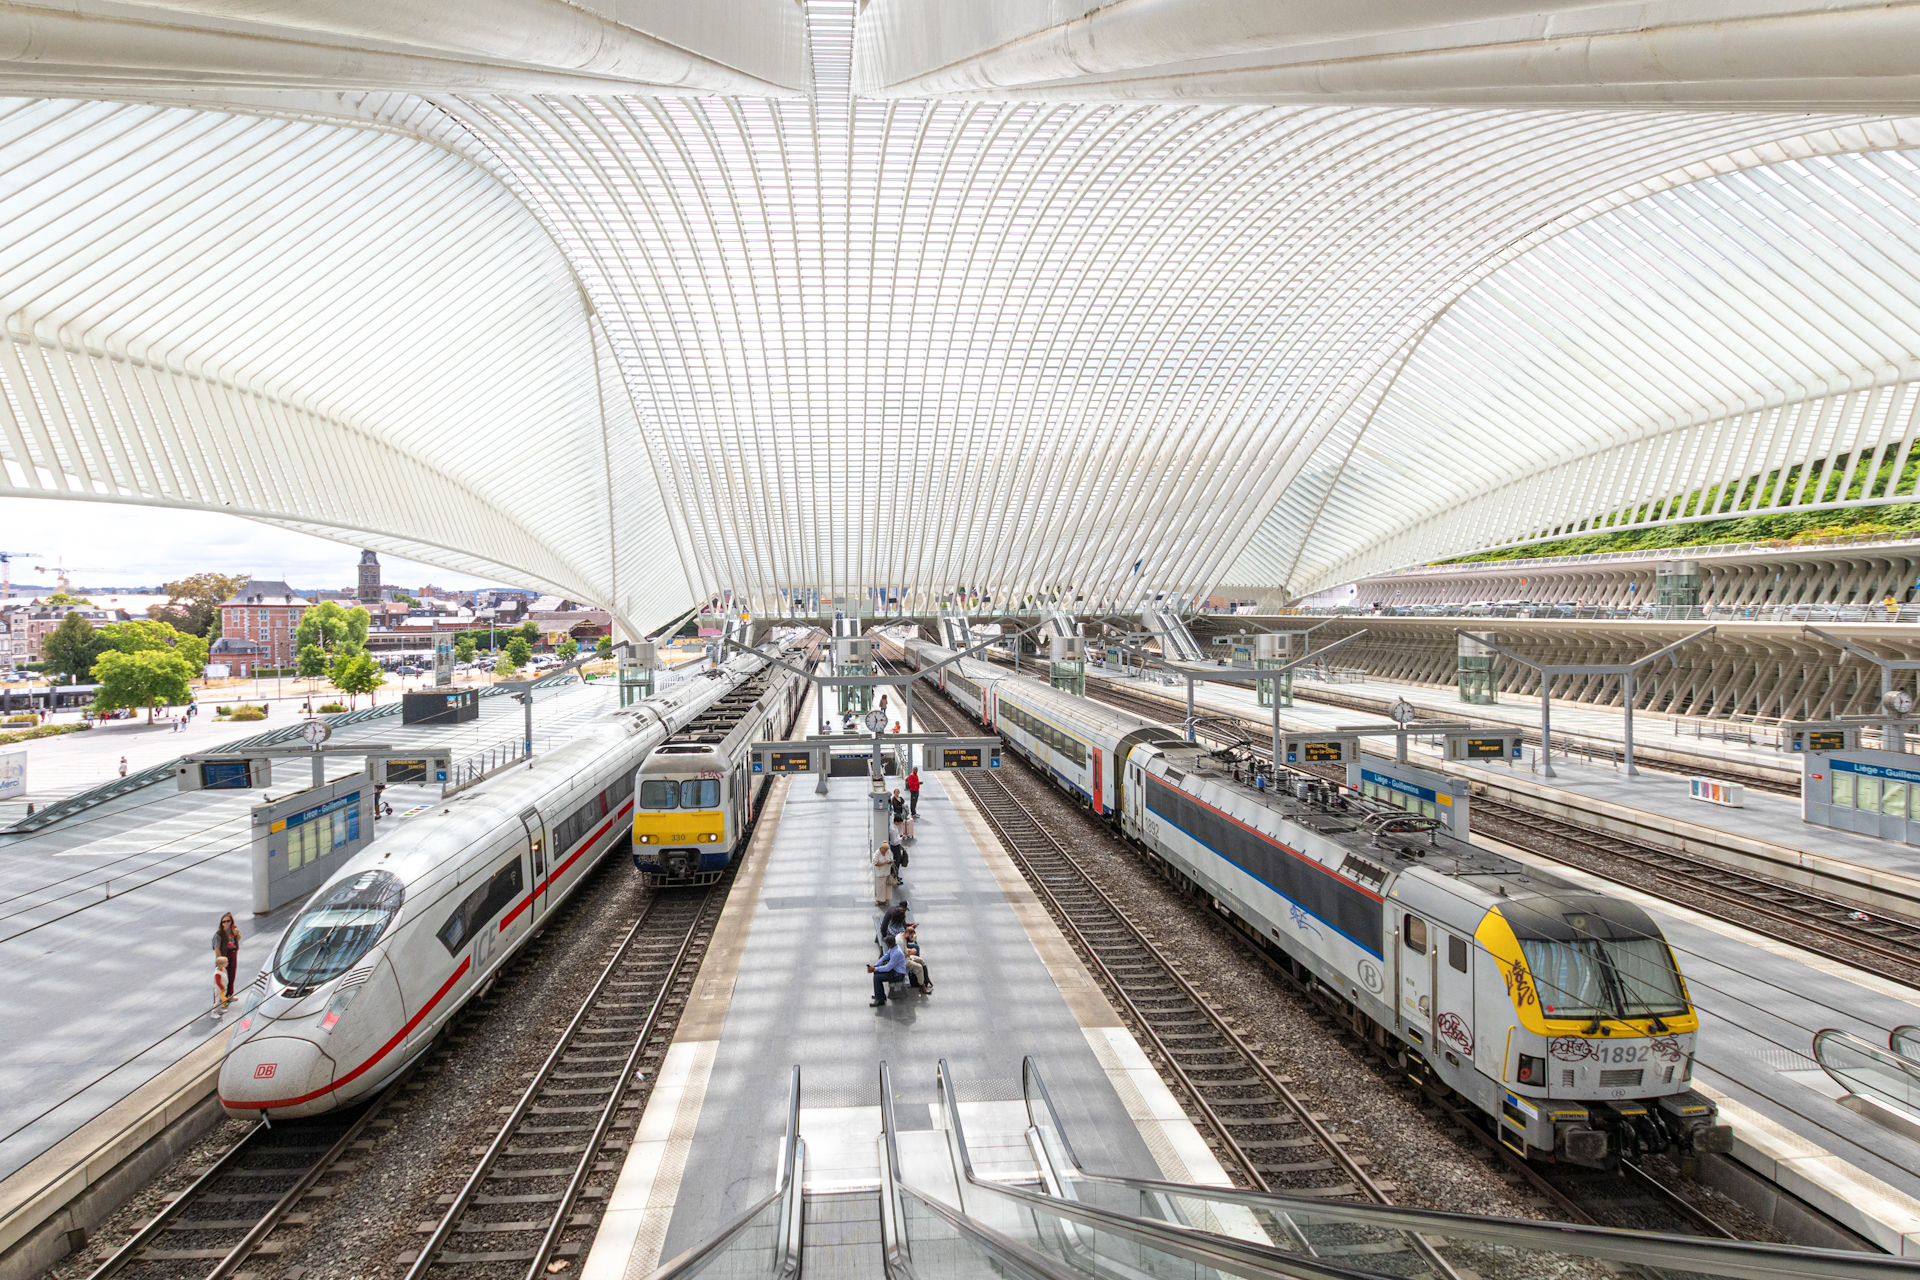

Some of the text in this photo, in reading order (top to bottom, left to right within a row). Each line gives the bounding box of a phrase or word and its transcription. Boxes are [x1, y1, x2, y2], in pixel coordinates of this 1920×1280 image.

[1854, 763, 1878, 774] Liège
[1374, 773, 1388, 785] Liège
[1391, 779, 1419, 794] Guillemins
[303, 809, 318, 820] Liège
[321, 798, 348, 813] Guillemins
[555, 833, 559, 845] 2
[471, 921, 498, 975] ICE
[1600, 1045, 1650, 1063] 1892
